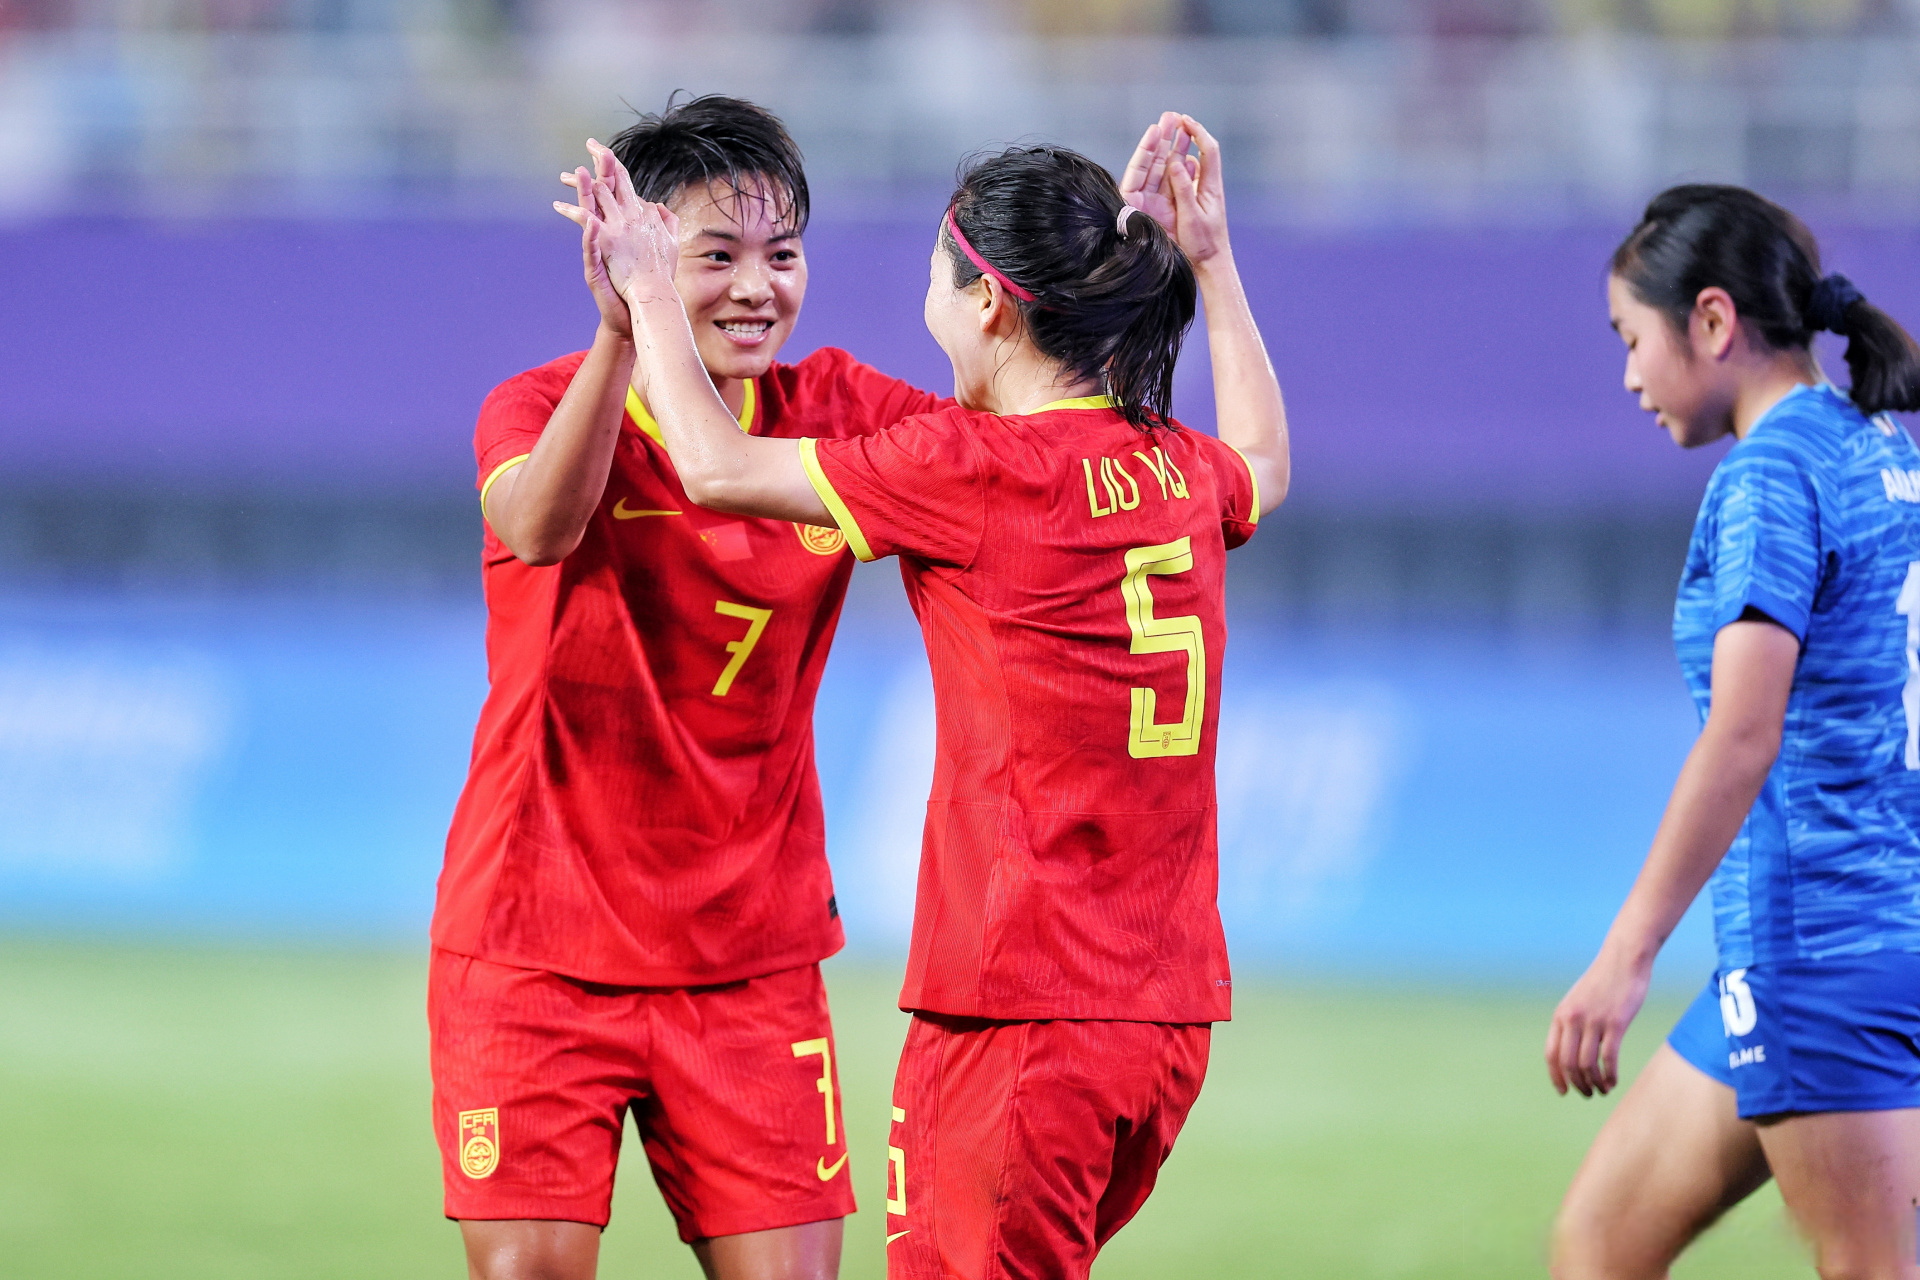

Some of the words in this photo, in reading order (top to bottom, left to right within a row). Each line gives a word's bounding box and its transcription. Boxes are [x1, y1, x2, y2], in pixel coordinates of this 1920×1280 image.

[1082, 456, 1140, 518] LIU
[711, 600, 773, 696] 7
[1120, 535, 1206, 759] 5
[462, 1113, 494, 1129] CFA
[791, 1037, 836, 1145] 7
